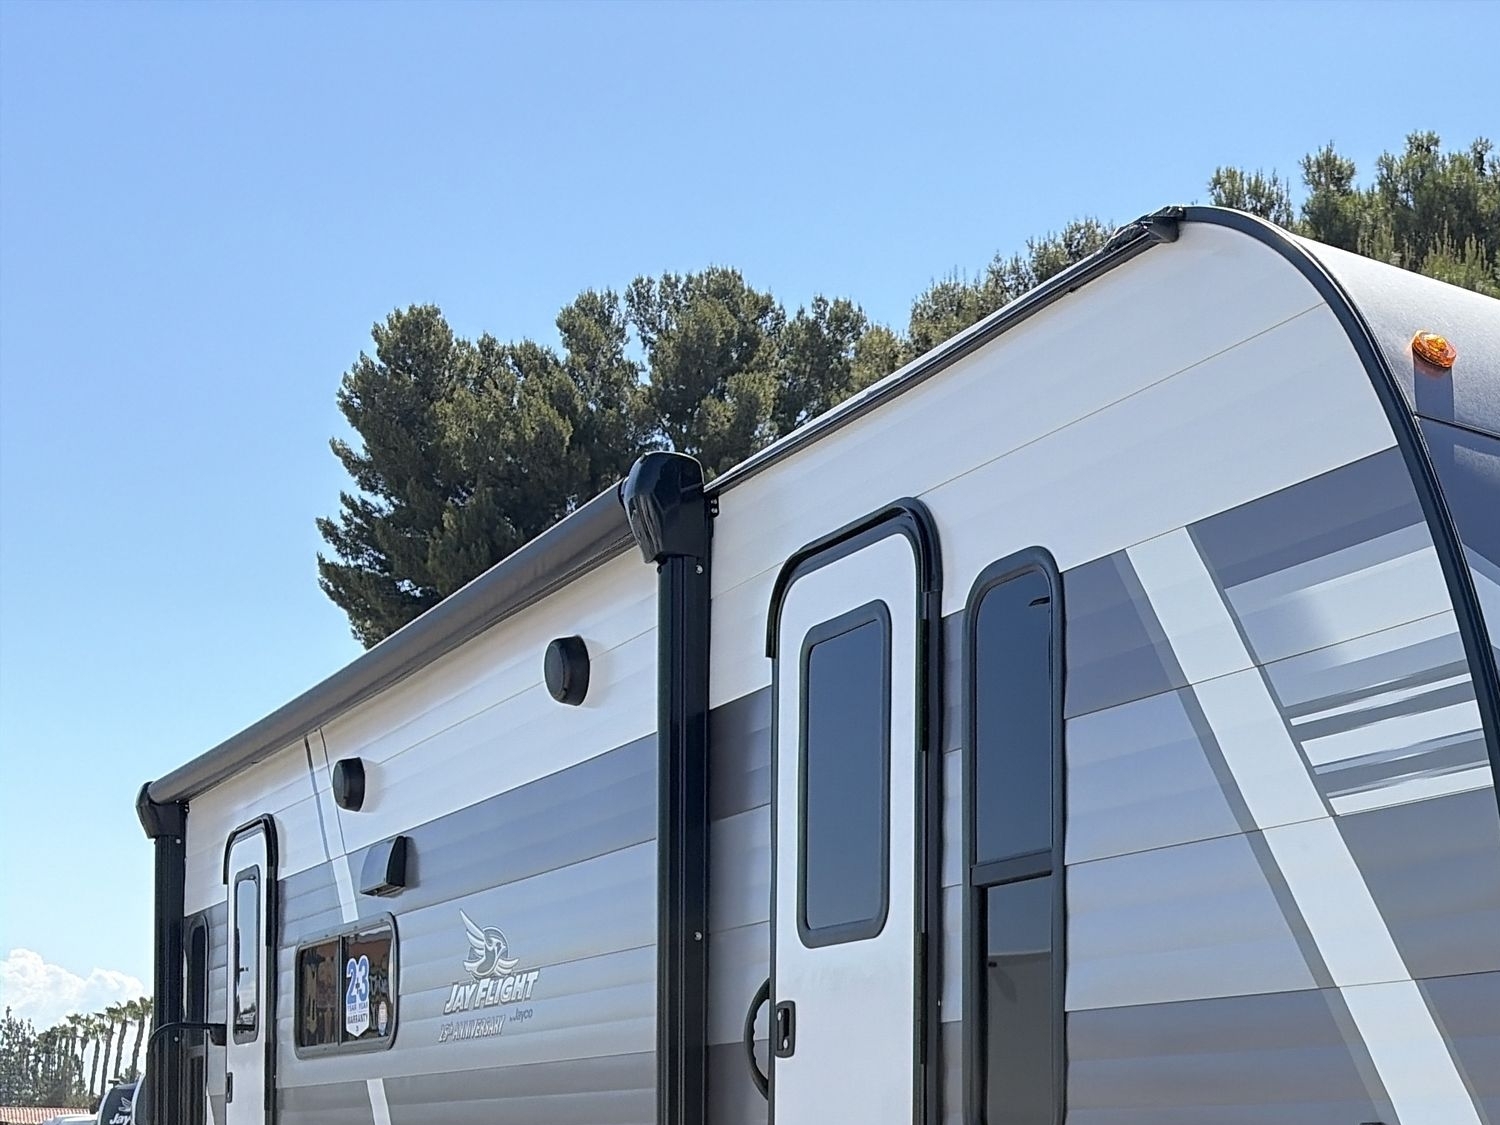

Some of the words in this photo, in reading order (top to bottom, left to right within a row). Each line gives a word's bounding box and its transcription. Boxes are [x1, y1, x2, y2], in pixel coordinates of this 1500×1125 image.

[443, 982, 477, 1016] JAY
[474, 969, 540, 1010] FLIGHT
[109, 1112, 131, 1125] Jay
